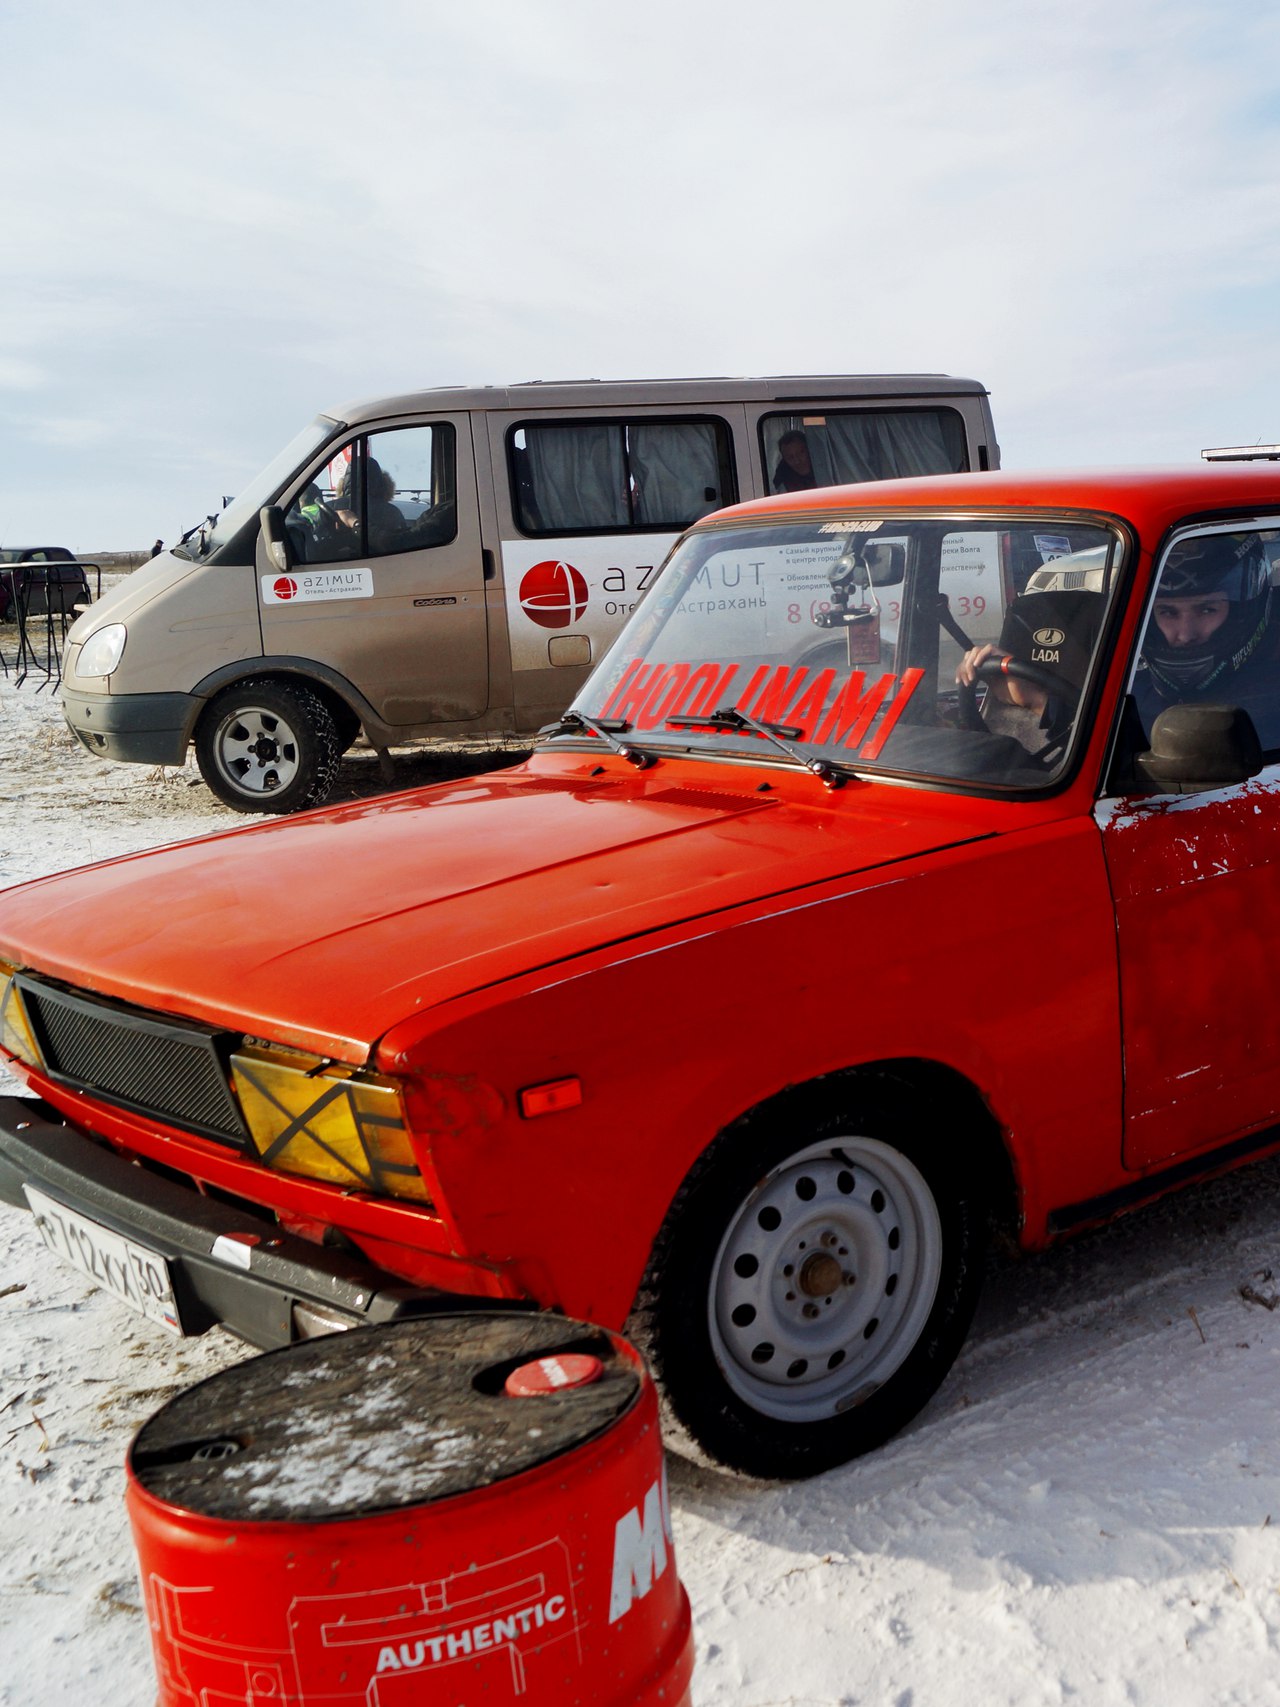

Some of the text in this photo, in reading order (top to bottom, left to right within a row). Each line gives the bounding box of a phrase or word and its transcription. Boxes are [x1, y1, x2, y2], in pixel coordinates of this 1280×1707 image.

[1031, 648, 1060, 663] LADA
[608, 1456, 674, 1626] M
[375, 1594, 567, 1674] AUTHENTIC
